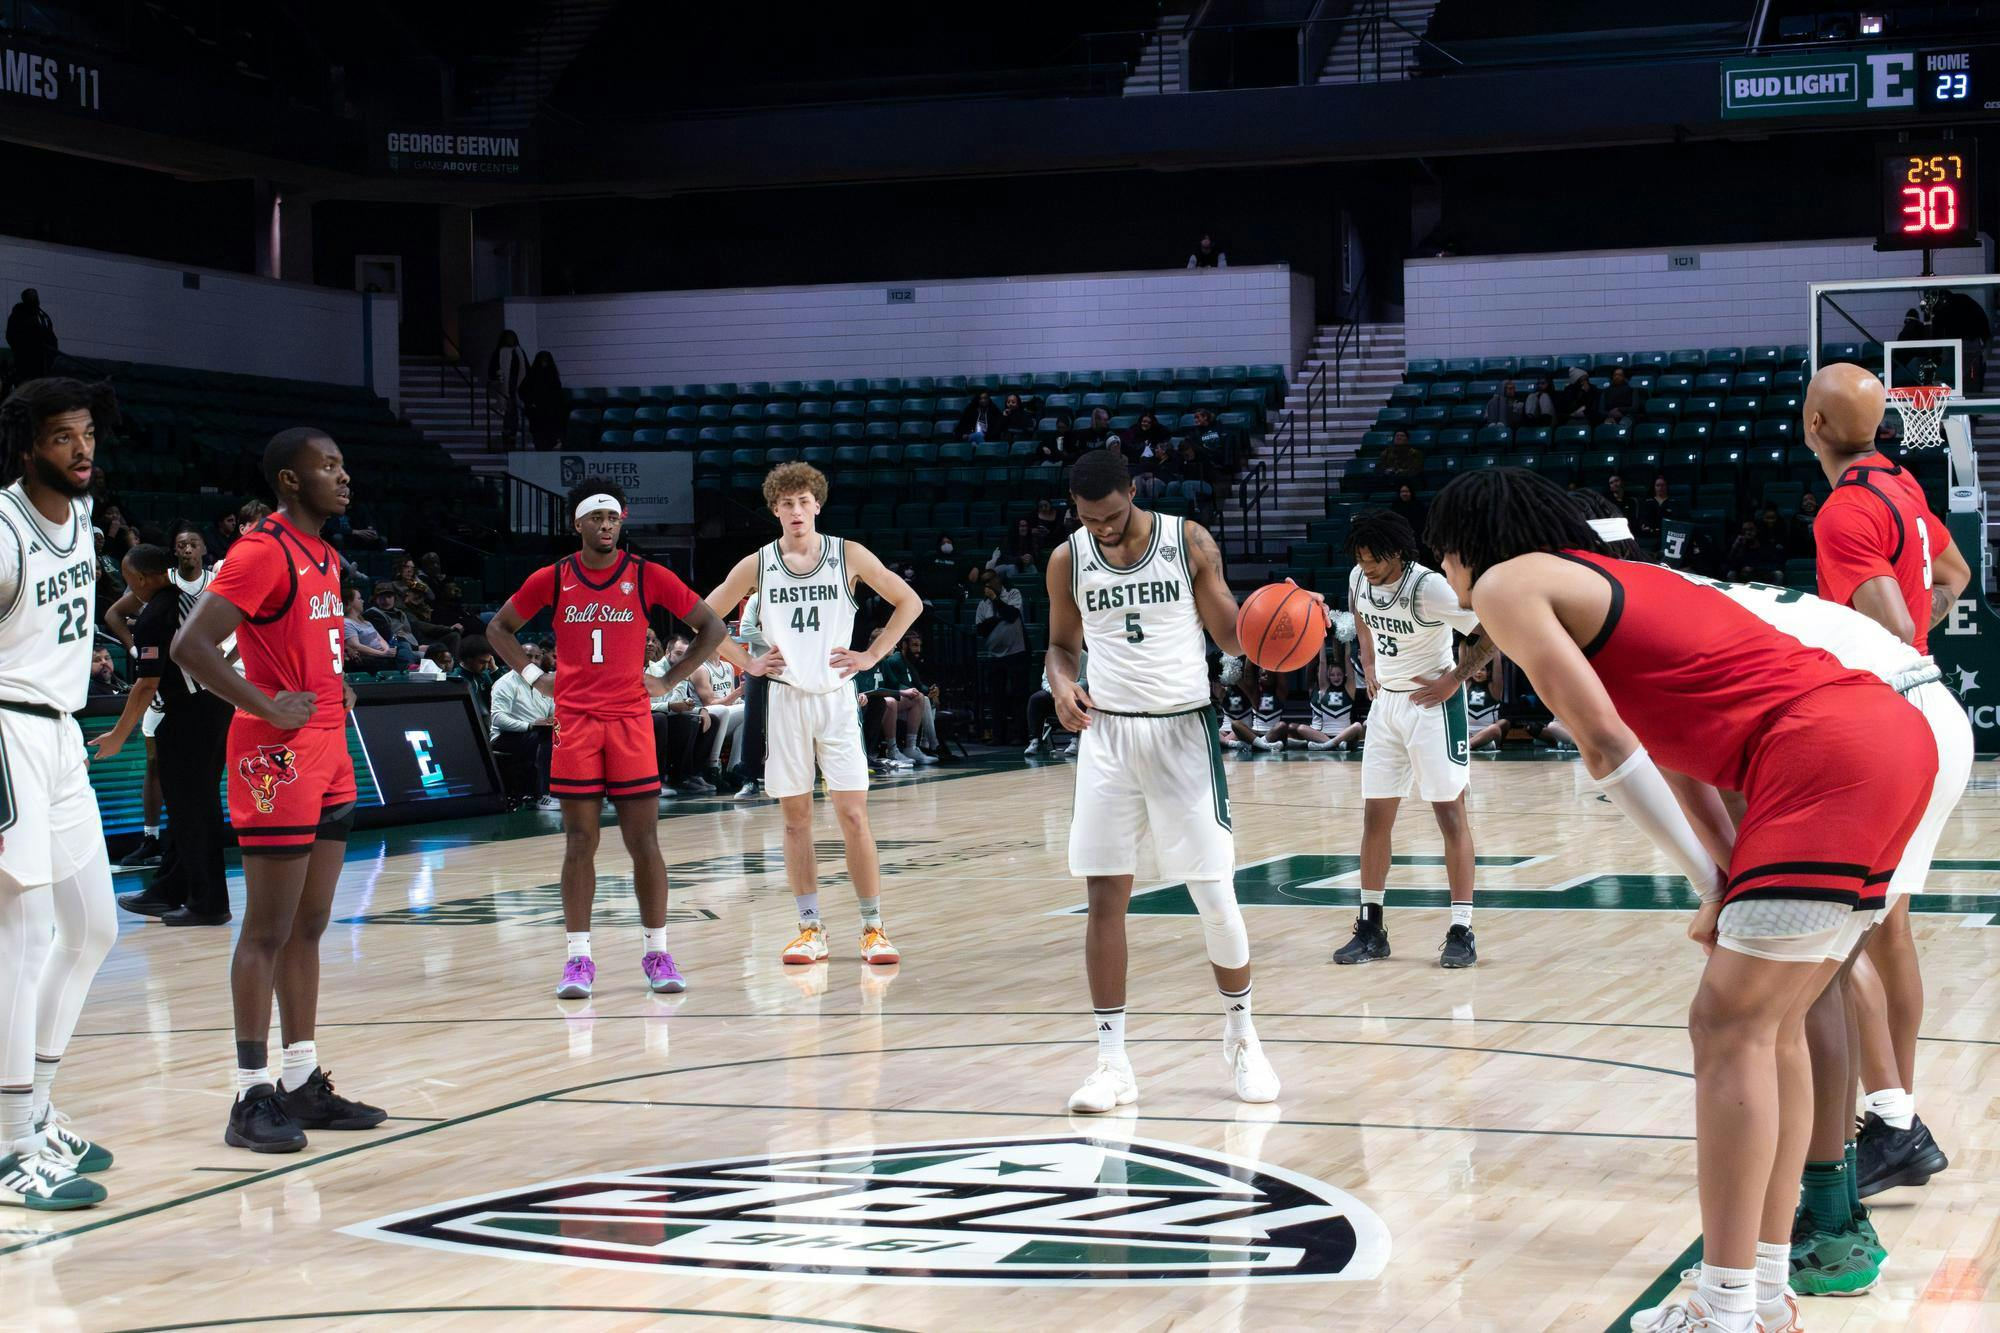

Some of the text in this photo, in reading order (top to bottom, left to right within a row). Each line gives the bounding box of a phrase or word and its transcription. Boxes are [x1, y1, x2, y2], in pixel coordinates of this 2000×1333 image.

[1926, 53, 1970, 71] HOME
[0, 48, 99, 110] MES '11
[1735, 72, 1849, 99] BUD LIGHT
[1866, 52, 1914, 108] E
[1936, 74, 1968, 99] 23
[387, 132, 519, 157] GEORGE GERVIN
[1907, 155, 1961, 183] 2:57
[1903, 186, 1954, 231] 30
[1674, 256, 1693, 266] 101
[891, 291, 912, 300] 102
[588, 463, 638, 474] PUFFER
[1915, 516, 1932, 590] 3
[309, 590, 332, 620] Ball
[769, 584, 838, 604] EASTERN
[1085, 580, 1180, 612] EASTERN
[57, 596, 88, 645] 22
[564, 602, 634, 623] Ball State
[790, 606, 820, 633] 44
[1945, 600, 1977, 635] E
[1125, 612, 1145, 644] 5
[328, 628, 343, 675] 5
[591, 629, 604, 663] 1
[1377, 633, 1399, 657] 55
[1259, 696, 1274, 710] E
[1328, 692, 1343, 706] E
[1469, 690, 1485, 706] E
[405, 731, 444, 787] E
[1457, 740, 1467, 755] E
[707, 1232, 977, 1253] 1946
